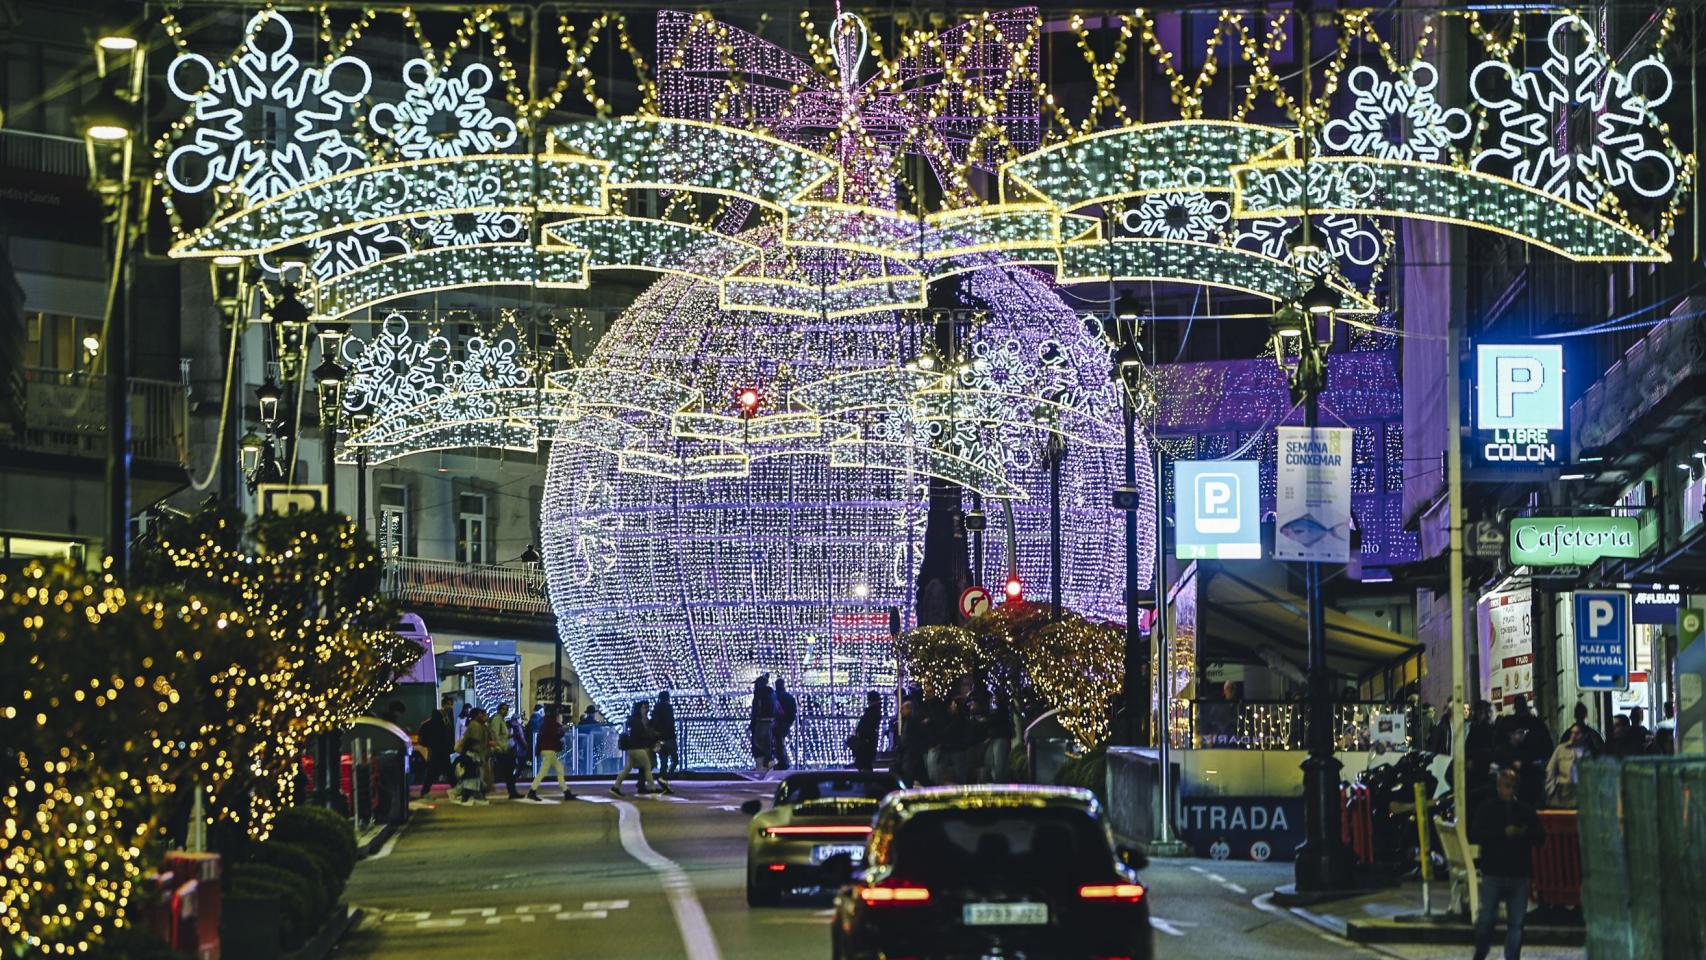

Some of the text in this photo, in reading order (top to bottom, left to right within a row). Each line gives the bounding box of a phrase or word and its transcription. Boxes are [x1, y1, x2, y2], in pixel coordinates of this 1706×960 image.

[1496, 356, 1545, 418] P
[1494, 428, 1548, 444] LIBRE
[1286, 441, 1328, 454] SEMANA
[1484, 443, 1555, 462] COLON
[1285, 453, 1342, 467] CONXEMAR
[1588, 600, 1614, 638] P
[1580, 645, 1622, 654] PLAZA DE
[1580, 656, 1623, 666] PORTUGAL
[1255, 847, 1268, 857] 10
